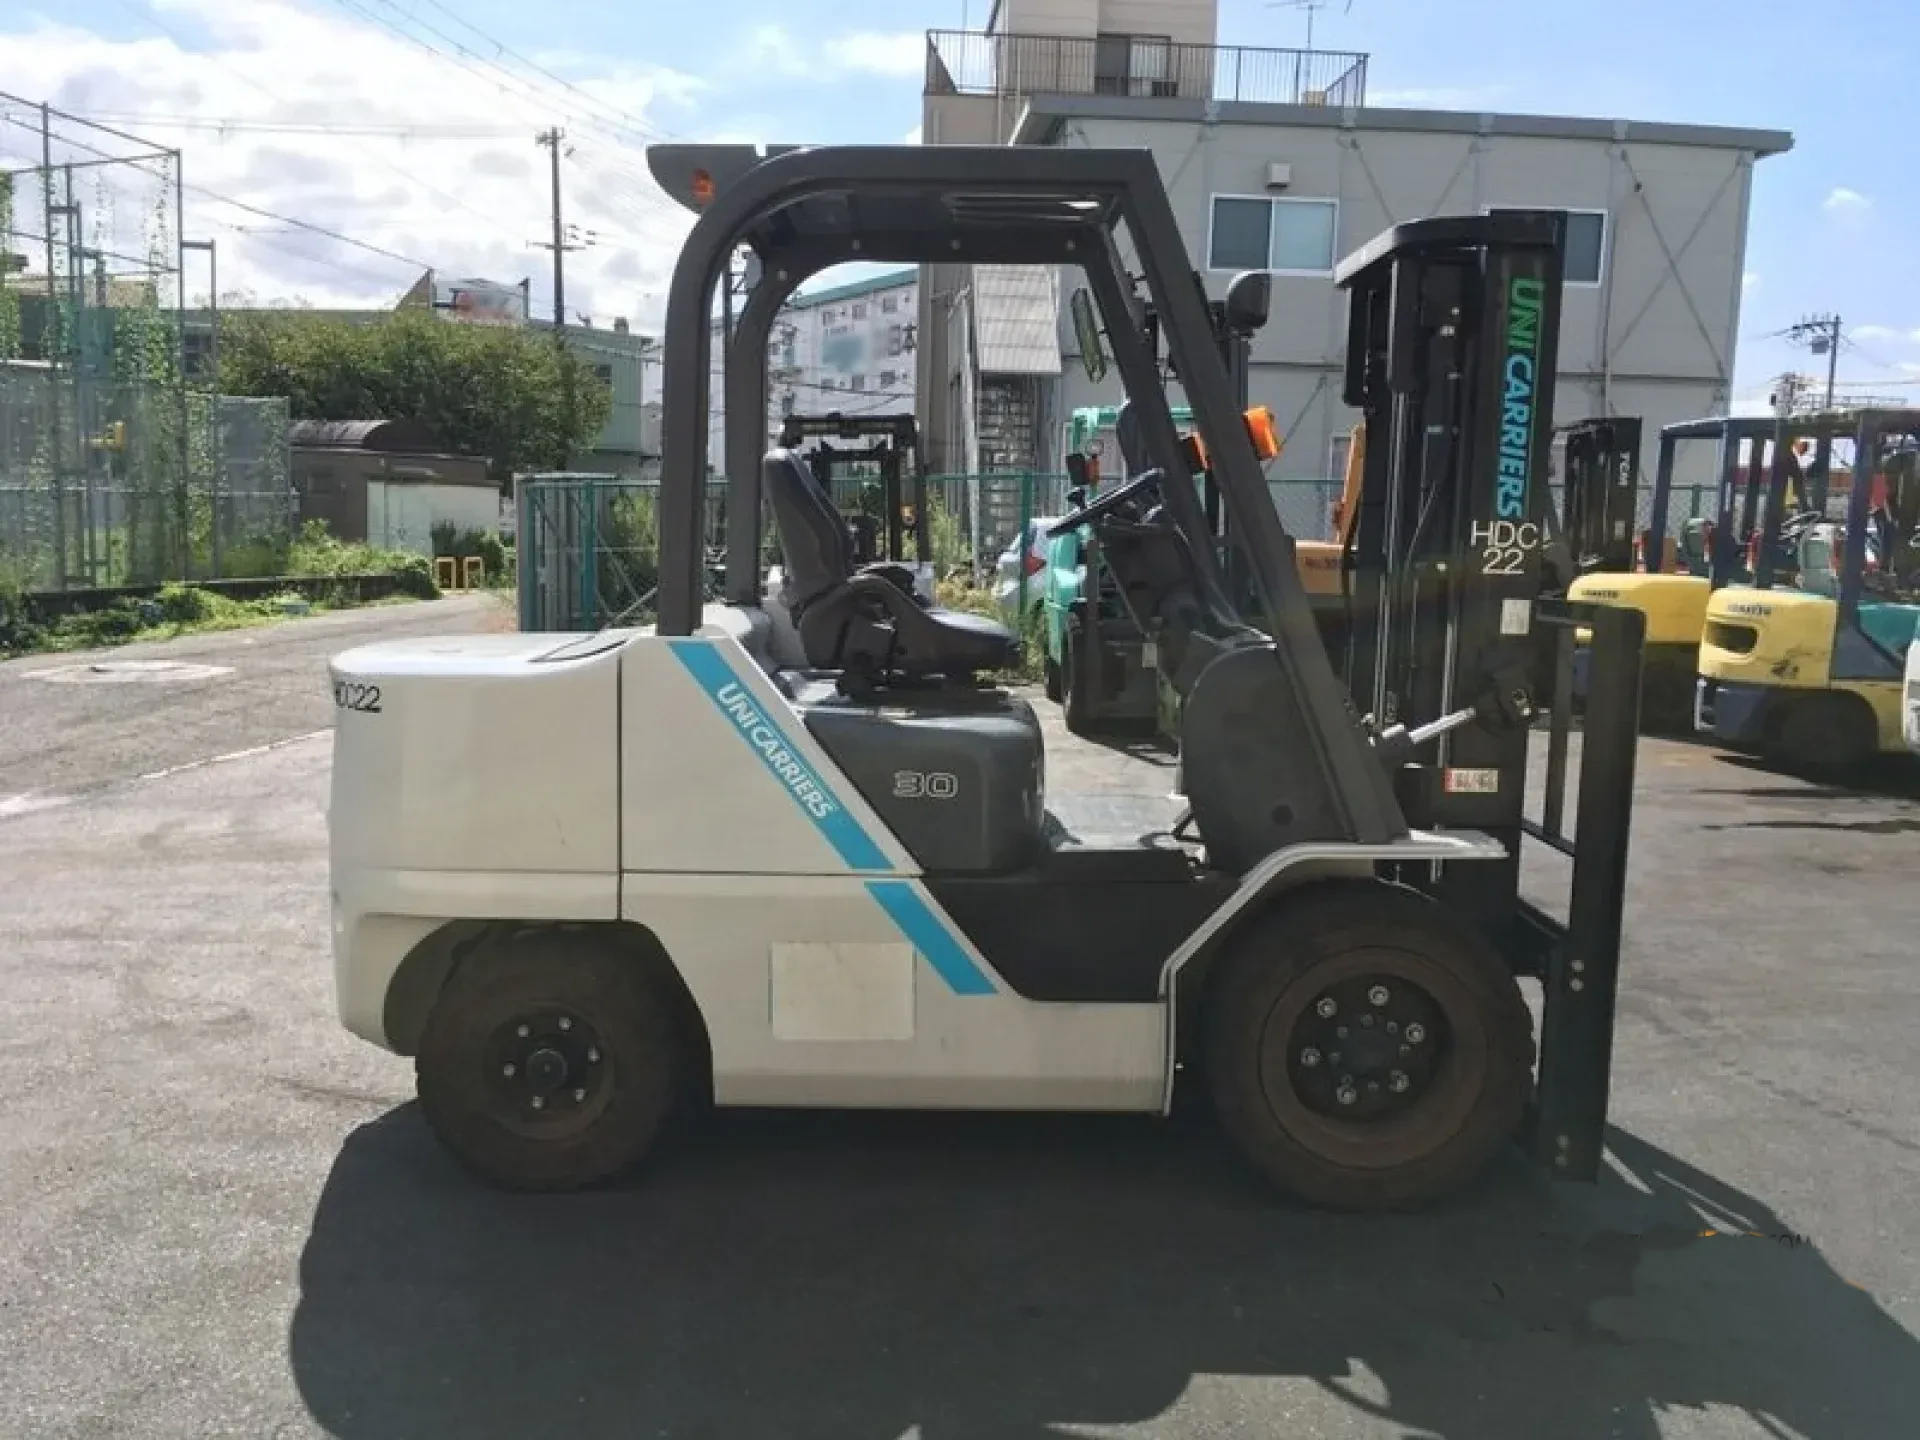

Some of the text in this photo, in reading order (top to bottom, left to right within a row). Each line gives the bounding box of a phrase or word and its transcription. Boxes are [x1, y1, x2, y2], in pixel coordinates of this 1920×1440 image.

[1470, 519, 1538, 549] HDC
[1482, 547, 1525, 574] 22
[893, 769, 959, 798] 30
